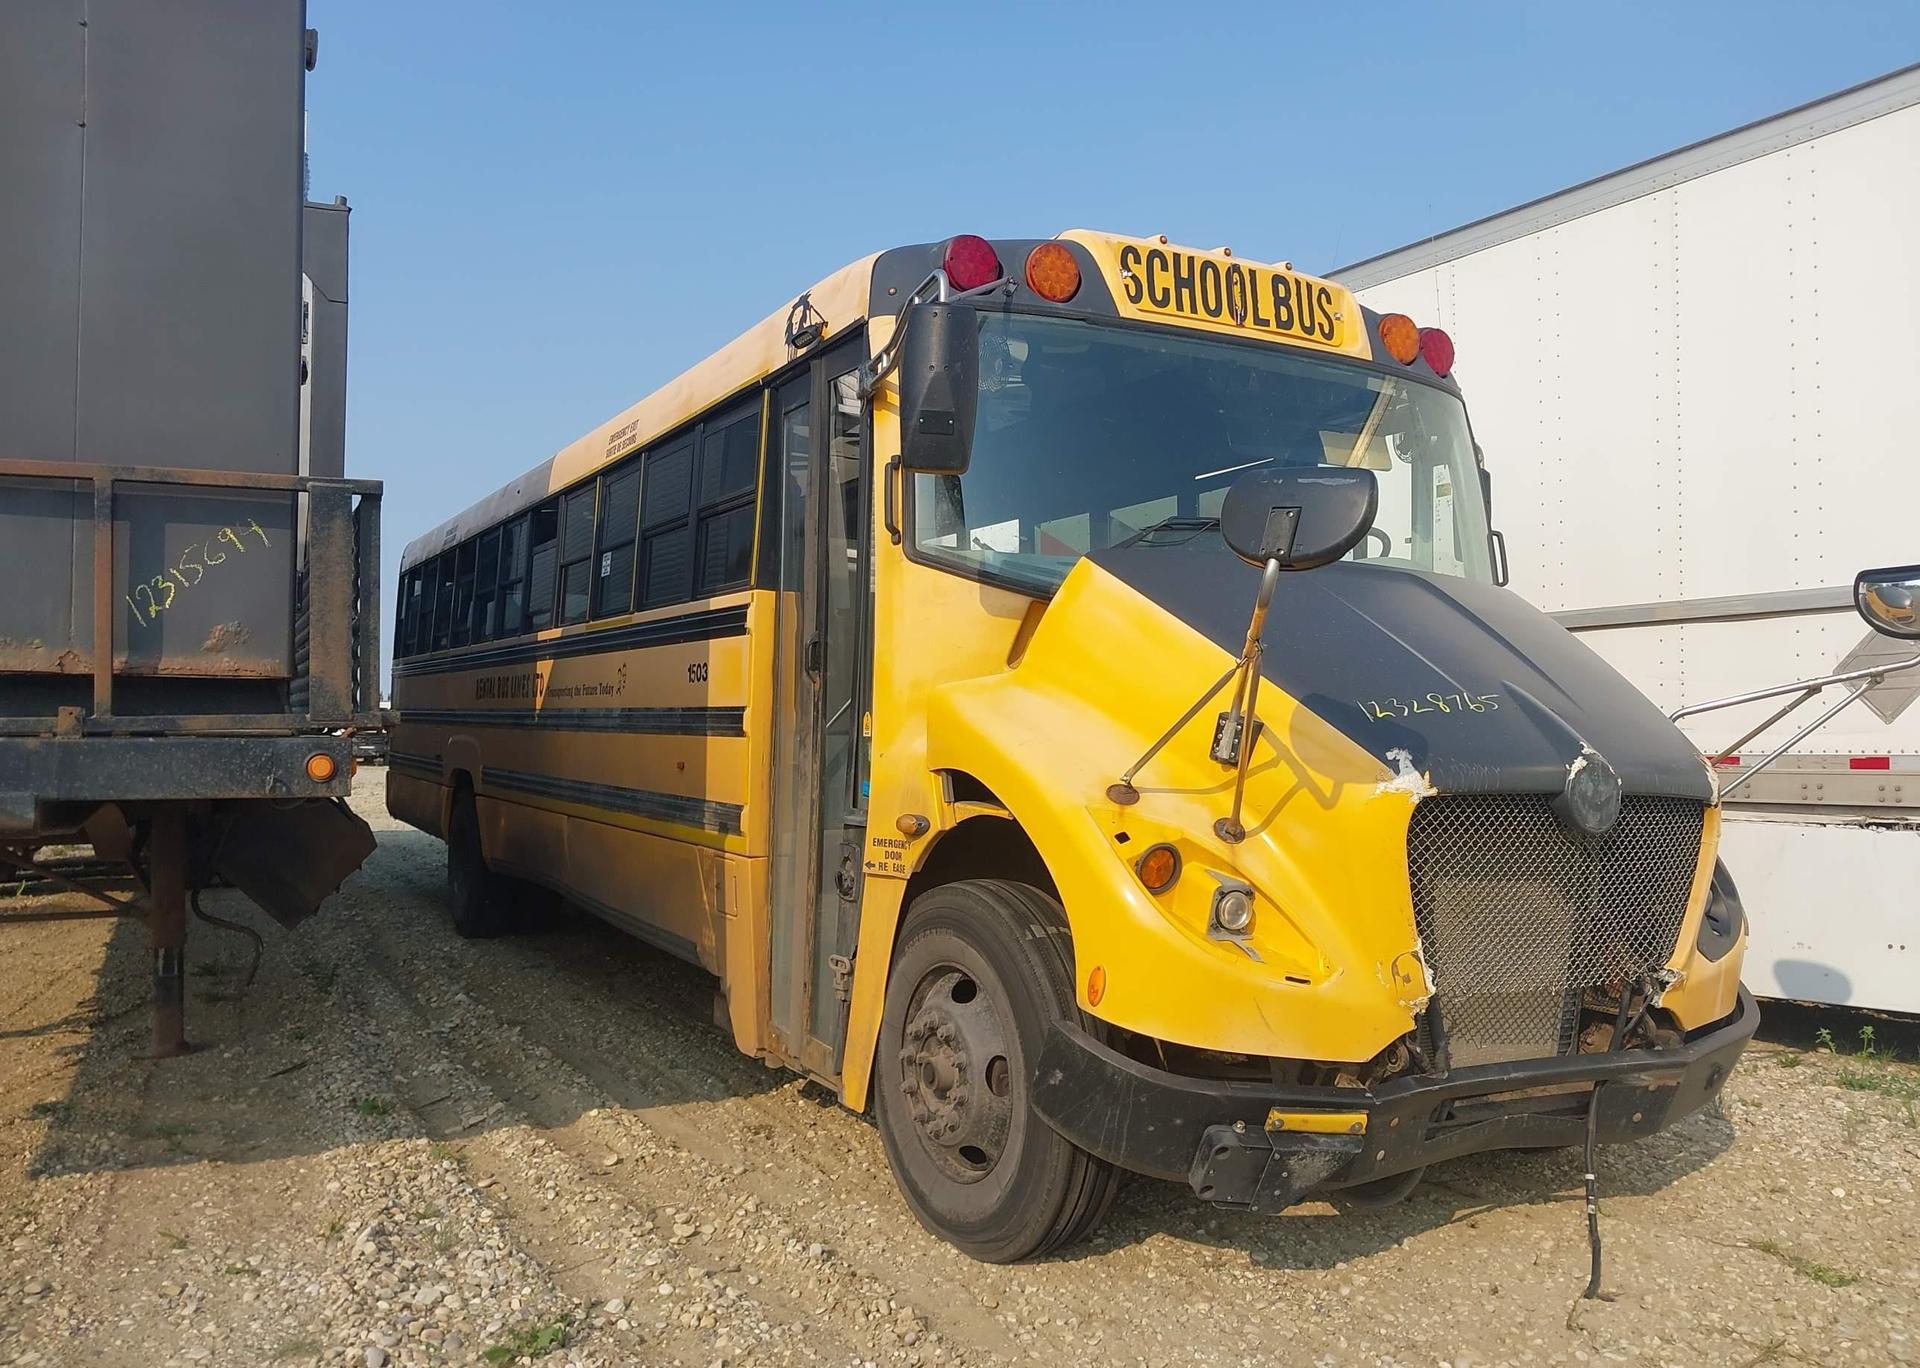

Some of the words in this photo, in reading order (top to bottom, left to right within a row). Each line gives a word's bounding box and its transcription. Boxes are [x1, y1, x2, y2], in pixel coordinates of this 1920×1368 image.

[1119, 244, 1271, 328] SCHOOL
[1271, 273, 1335, 342] BUS
[687, 661, 708, 684] 1503
[573, 684, 582, 697] the
[582, 683, 598, 697] Future
[599, 682, 614, 698] Today
[1354, 692, 1500, 723] 12328765
[872, 837, 911, 851] EMERGENCY
[884, 850, 903, 862] DOOR
[878, 861, 906, 875] REEASE
